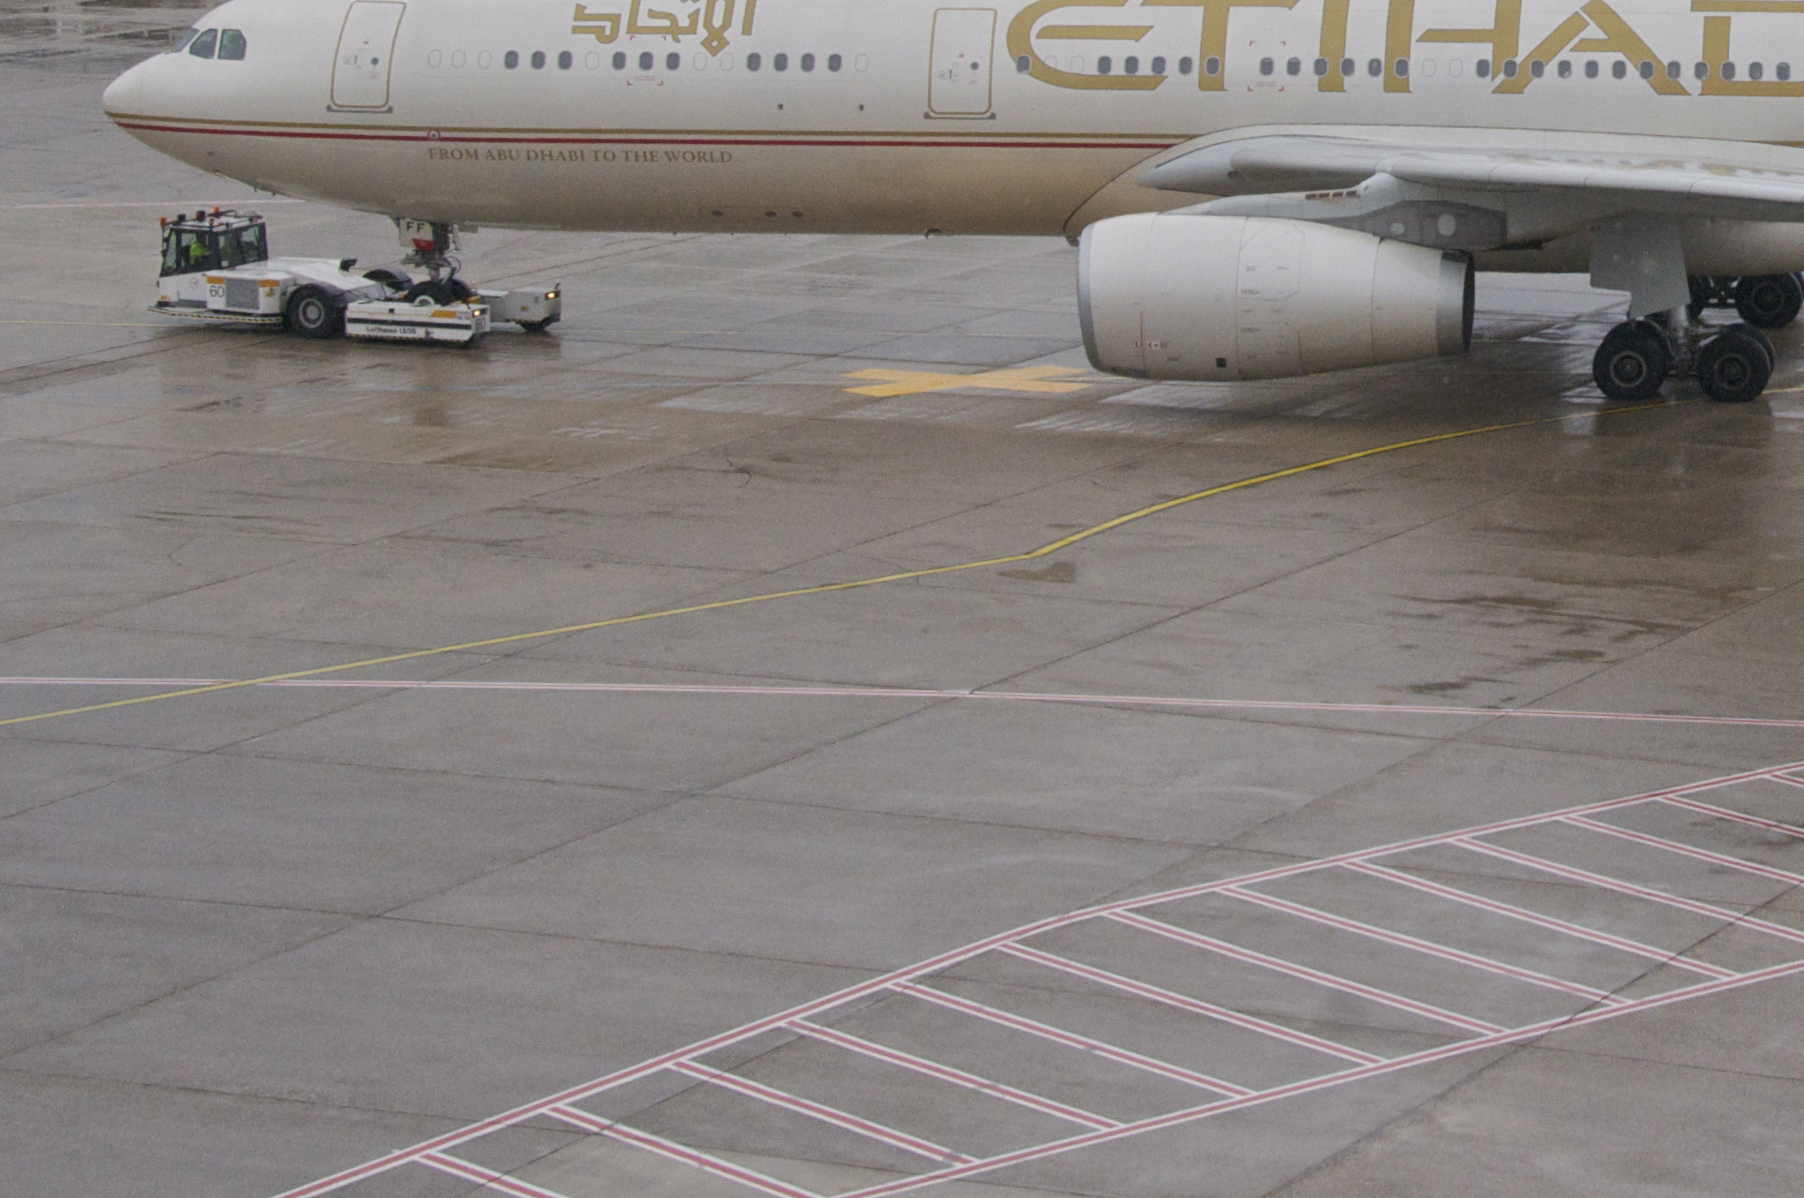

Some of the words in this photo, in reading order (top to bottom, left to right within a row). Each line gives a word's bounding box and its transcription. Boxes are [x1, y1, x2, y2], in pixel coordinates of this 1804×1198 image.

[428, 147, 479, 161] FROM
[484, 148, 521, 161] ABU
[526, 149, 585, 162] DHABI
[593, 150, 616, 162] TO
[622, 150, 660, 163] THE
[665, 150, 733, 164] WORLD
[406, 221, 425, 233] FF
[209, 285, 225, 298] 60
